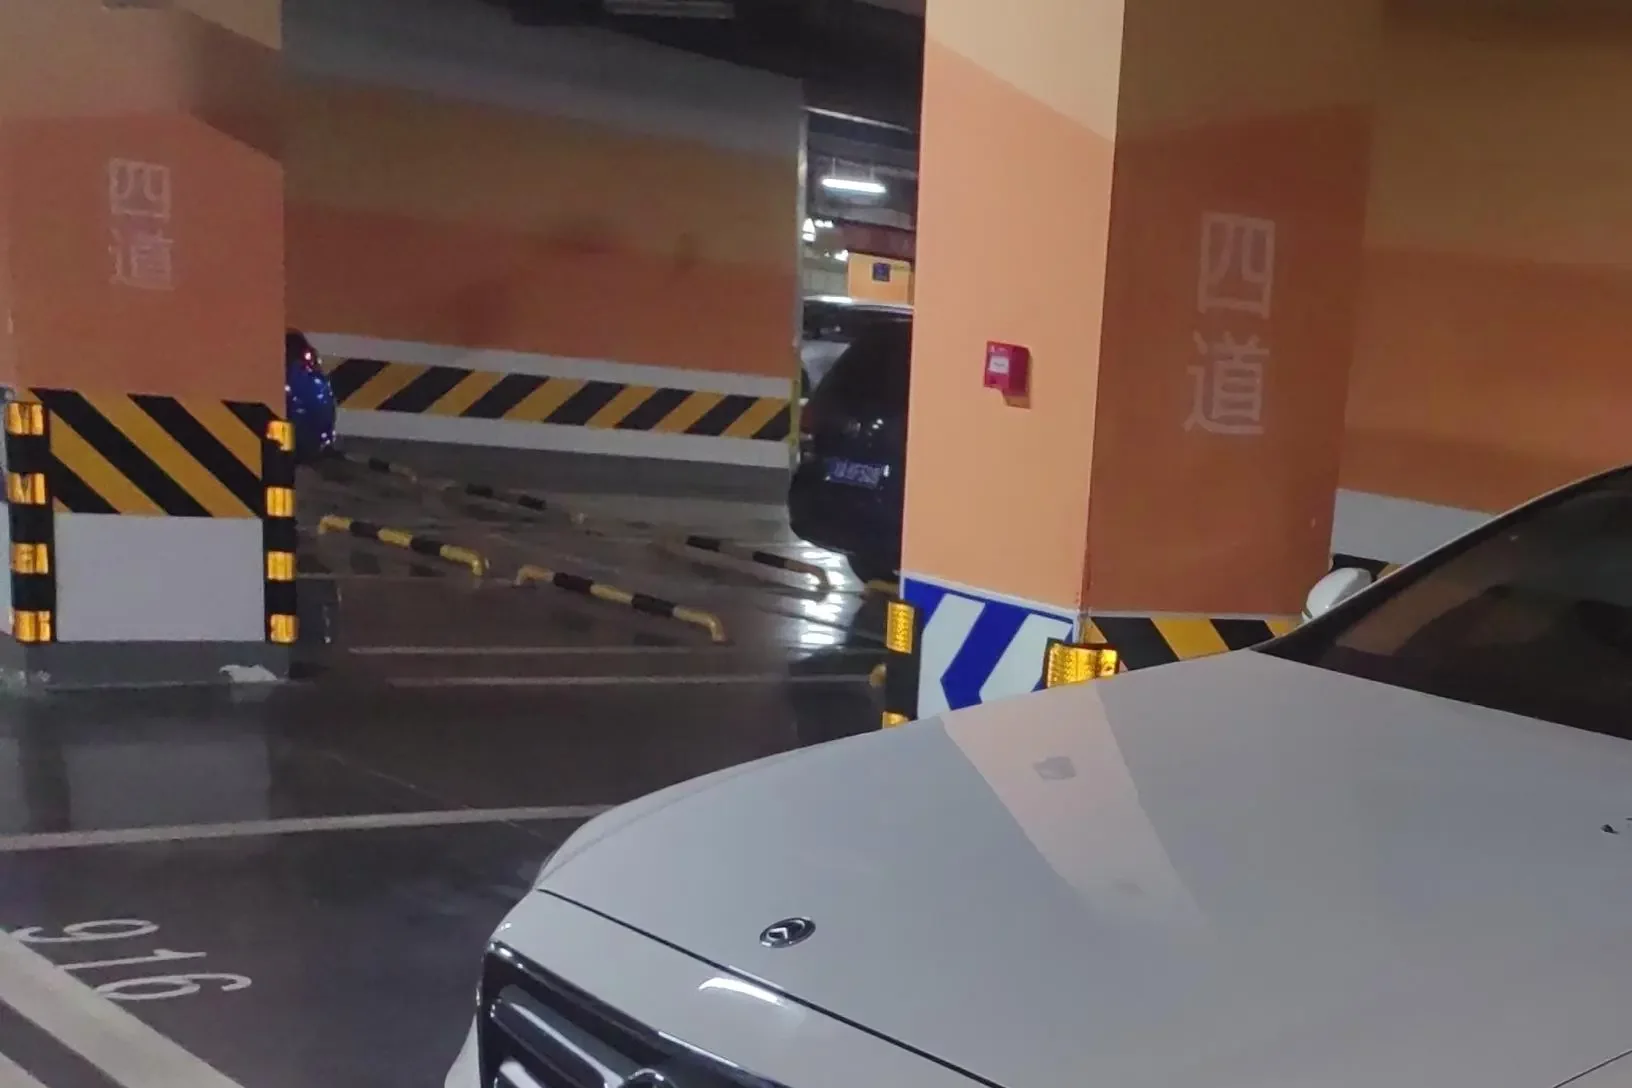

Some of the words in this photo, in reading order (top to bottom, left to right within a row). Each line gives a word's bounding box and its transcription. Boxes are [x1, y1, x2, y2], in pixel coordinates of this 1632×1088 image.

[109, 158, 174, 290] 四道
[1183, 211, 1276, 435] 四道
[12, 919, 252, 1000] 916
